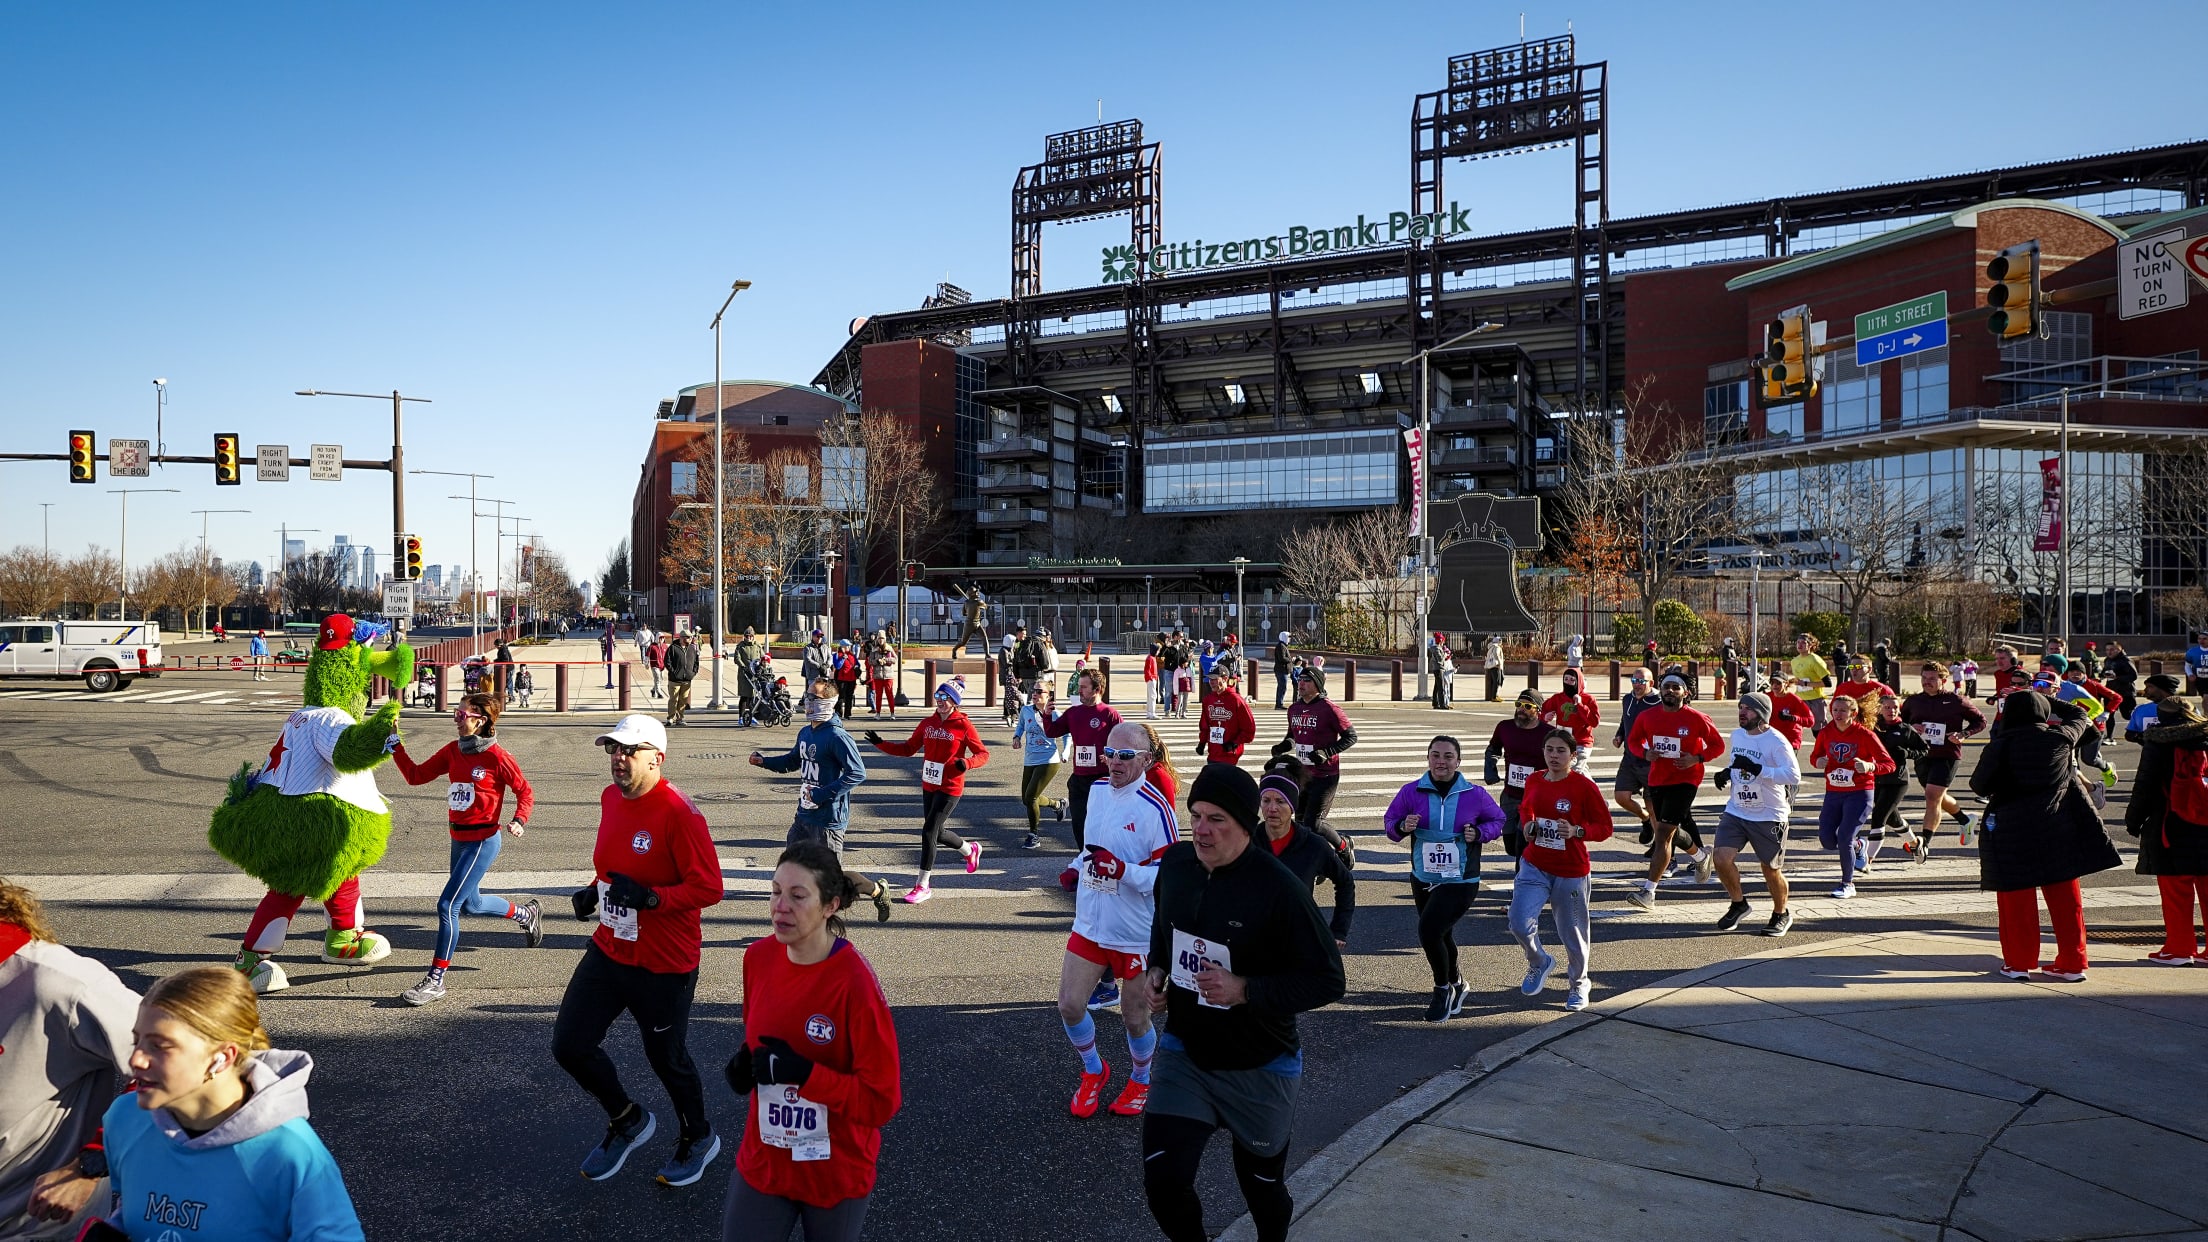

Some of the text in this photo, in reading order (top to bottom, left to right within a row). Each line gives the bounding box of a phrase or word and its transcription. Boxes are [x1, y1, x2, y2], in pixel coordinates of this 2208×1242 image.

[1148, 201, 1472, 272] Citizens Bank Park
[2136, 242, 2166, 263] NO
[2133, 259, 2171, 279] TURN
[2143, 278, 2162, 293] ON
[2139, 294, 2167, 310] RED
[1868, 302, 1932, 331] 11TH STREET
[1878, 339, 1895, 354] D-J
[113, 467, 127, 475] THE
[326, 628, 334, 638] P
[1291, 716, 1317, 727] PHILLIES
[1925, 728, 1941, 736] 4719
[1656, 743, 1677, 751] 5549
[1834, 743, 1850, 763] P
[472, 769, 486, 779] 5K
[925, 768, 939, 777] 5912
[1831, 774, 1849, 782] 2434
[451, 791, 470, 802] 2764
[1737, 792, 1757, 800] 1944
[1556, 802, 1570, 811] 5K
[633, 836, 649, 850] 5K
[1429, 852, 1452, 863] 3171
[1194, 942, 1206, 952] 5K
[807, 1021, 833, 1040] 5K
[785, 1090, 799, 1101] 5K
[769, 1103, 816, 1131] 5078
[144, 1192, 207, 1231] MaST
